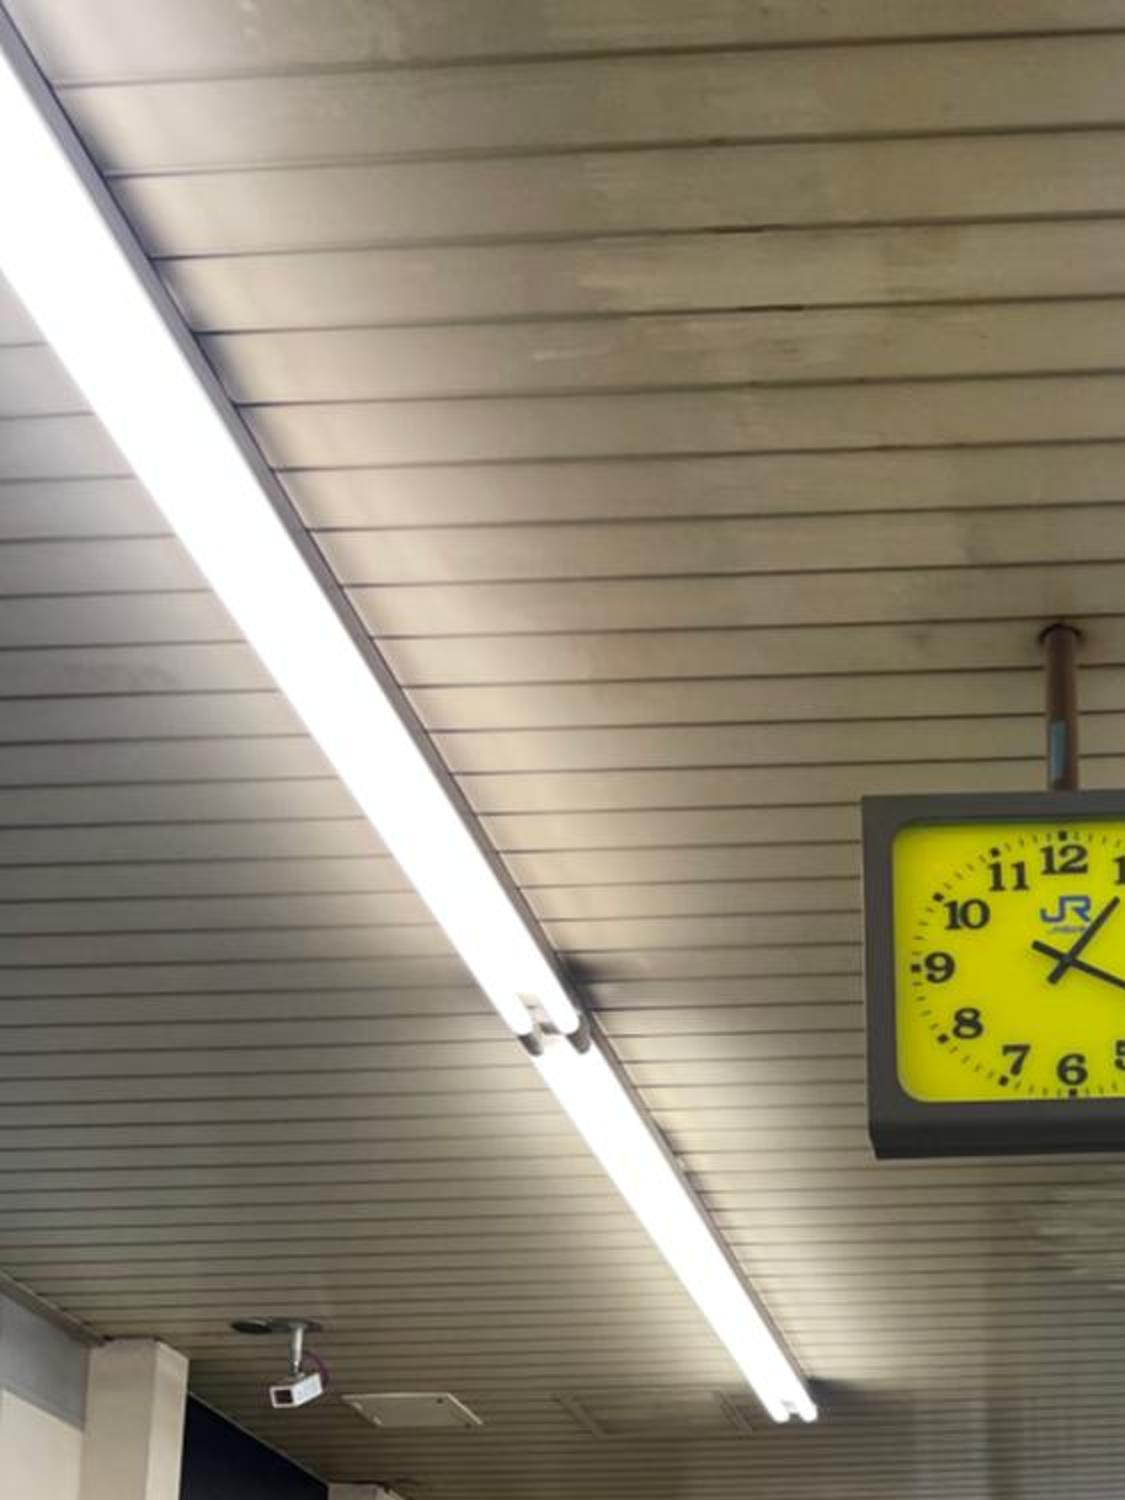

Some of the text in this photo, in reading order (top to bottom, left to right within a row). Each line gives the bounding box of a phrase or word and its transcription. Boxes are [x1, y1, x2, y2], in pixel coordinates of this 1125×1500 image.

[1040, 844, 1089, 876] 12
[988, 862, 1030, 892] 11
[944, 898, 991, 930] 10
[1040, 895, 1092, 922] JR
[923, 952, 956, 984] 9
[952, 1007, 985, 1040] 8
[1001, 1044, 1031, 1076] 7
[1056, 1054, 1089, 1086] 6
